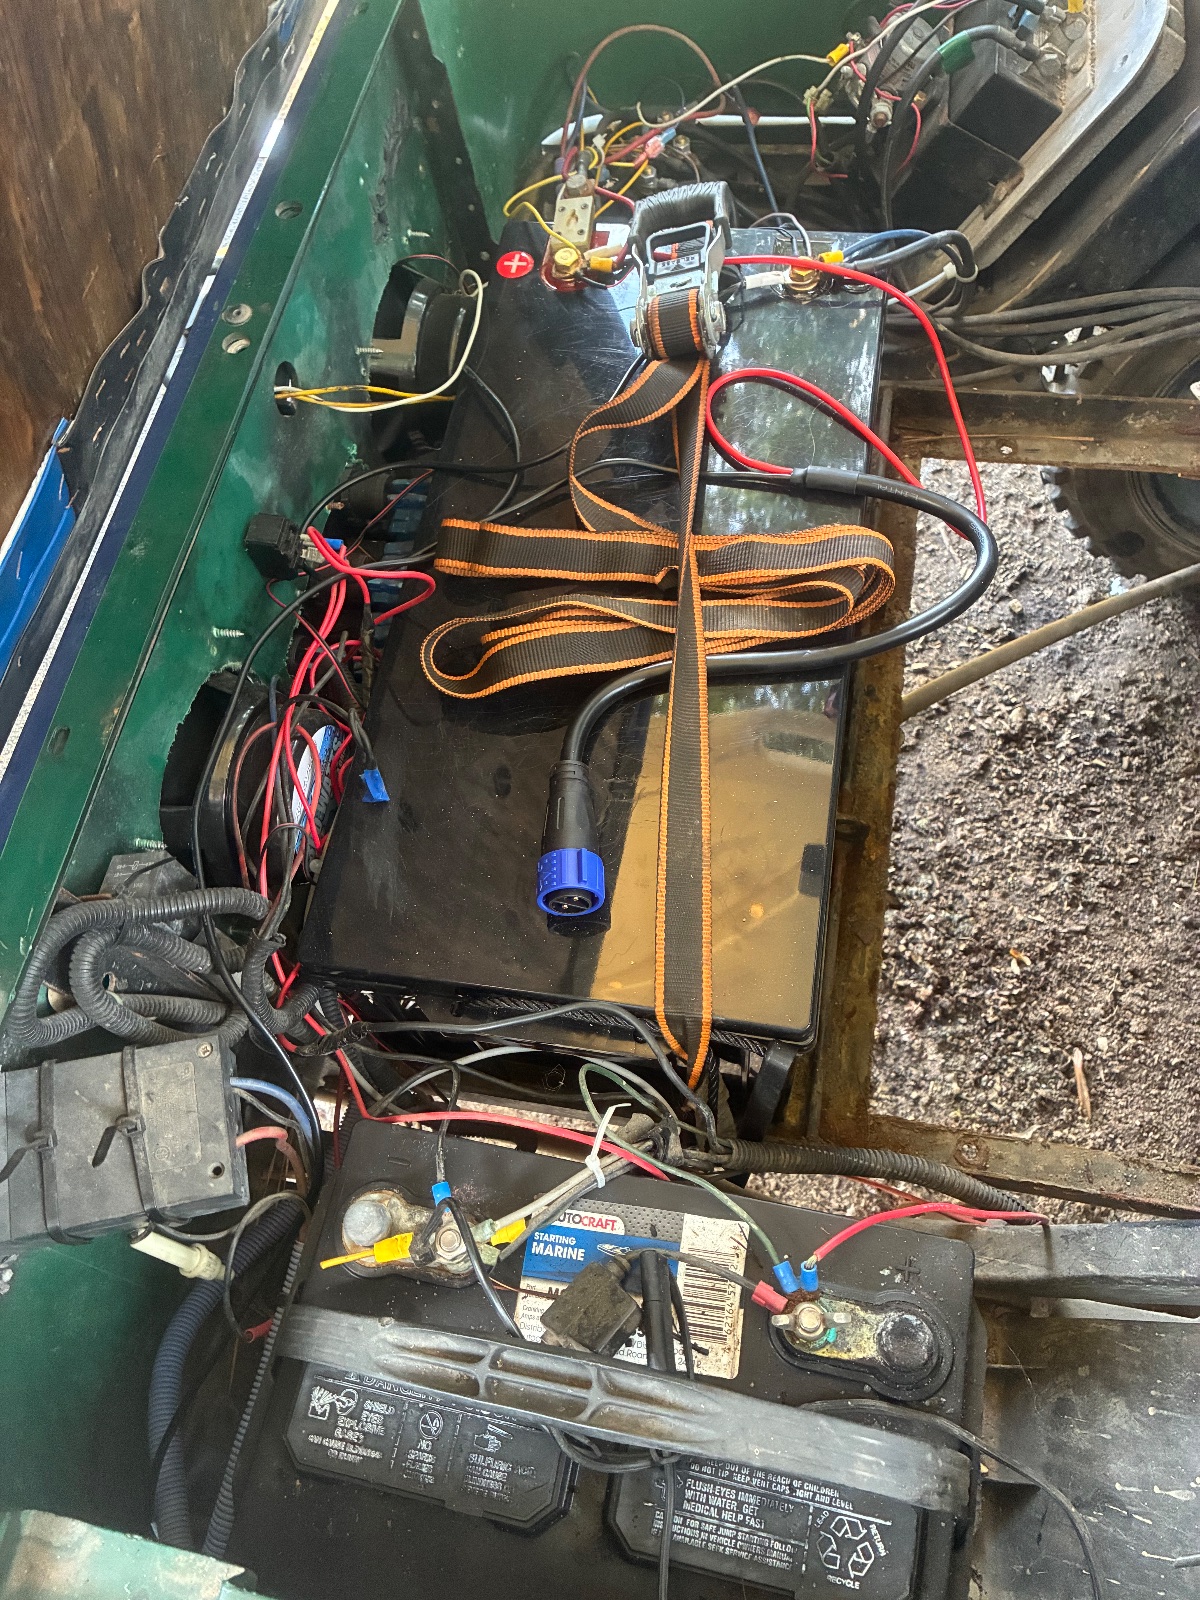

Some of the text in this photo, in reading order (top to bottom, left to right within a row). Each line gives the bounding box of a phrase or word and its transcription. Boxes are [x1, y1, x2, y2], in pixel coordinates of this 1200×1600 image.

[558, 1211, 617, 1232] UTOCRAFT
[534, 1231, 577, 1246] STARTING
[531, 1242, 586, 1262] MARINE
[417, 1438, 433, 1452] NO
[686, 1478, 795, 1513] FLUSH EYES IMMEDIATELY
[732, 1472, 751, 1484] KEEP
[752, 1477, 771, 1489] VENT
[771, 1482, 791, 1495] CAPS
[814, 1493, 831, 1505] AND
[831, 1498, 854, 1512] LEVEL
[767, 1473, 791, 1485] REACH
[792, 1479, 803, 1489] OF
[803, 1482, 840, 1499] CHILDREN
[684, 1488, 707, 1504] WITH
[742, 1503, 759, 1517] GET
[682, 1499, 765, 1530] MEDICAL HELP FAST
[814, 1510, 830, 1529] LEAD
[686, 1518, 700, 1529] FOR
[700, 1521, 717, 1534] SAFE
[717, 1526, 737, 1539] JUMP
[737, 1531, 769, 1548] STARTING
[709, 1533, 736, 1549] VEHICLE
[869, 1523, 888, 1557] RETURN
[827, 1574, 861, 1590] RECYCLE
